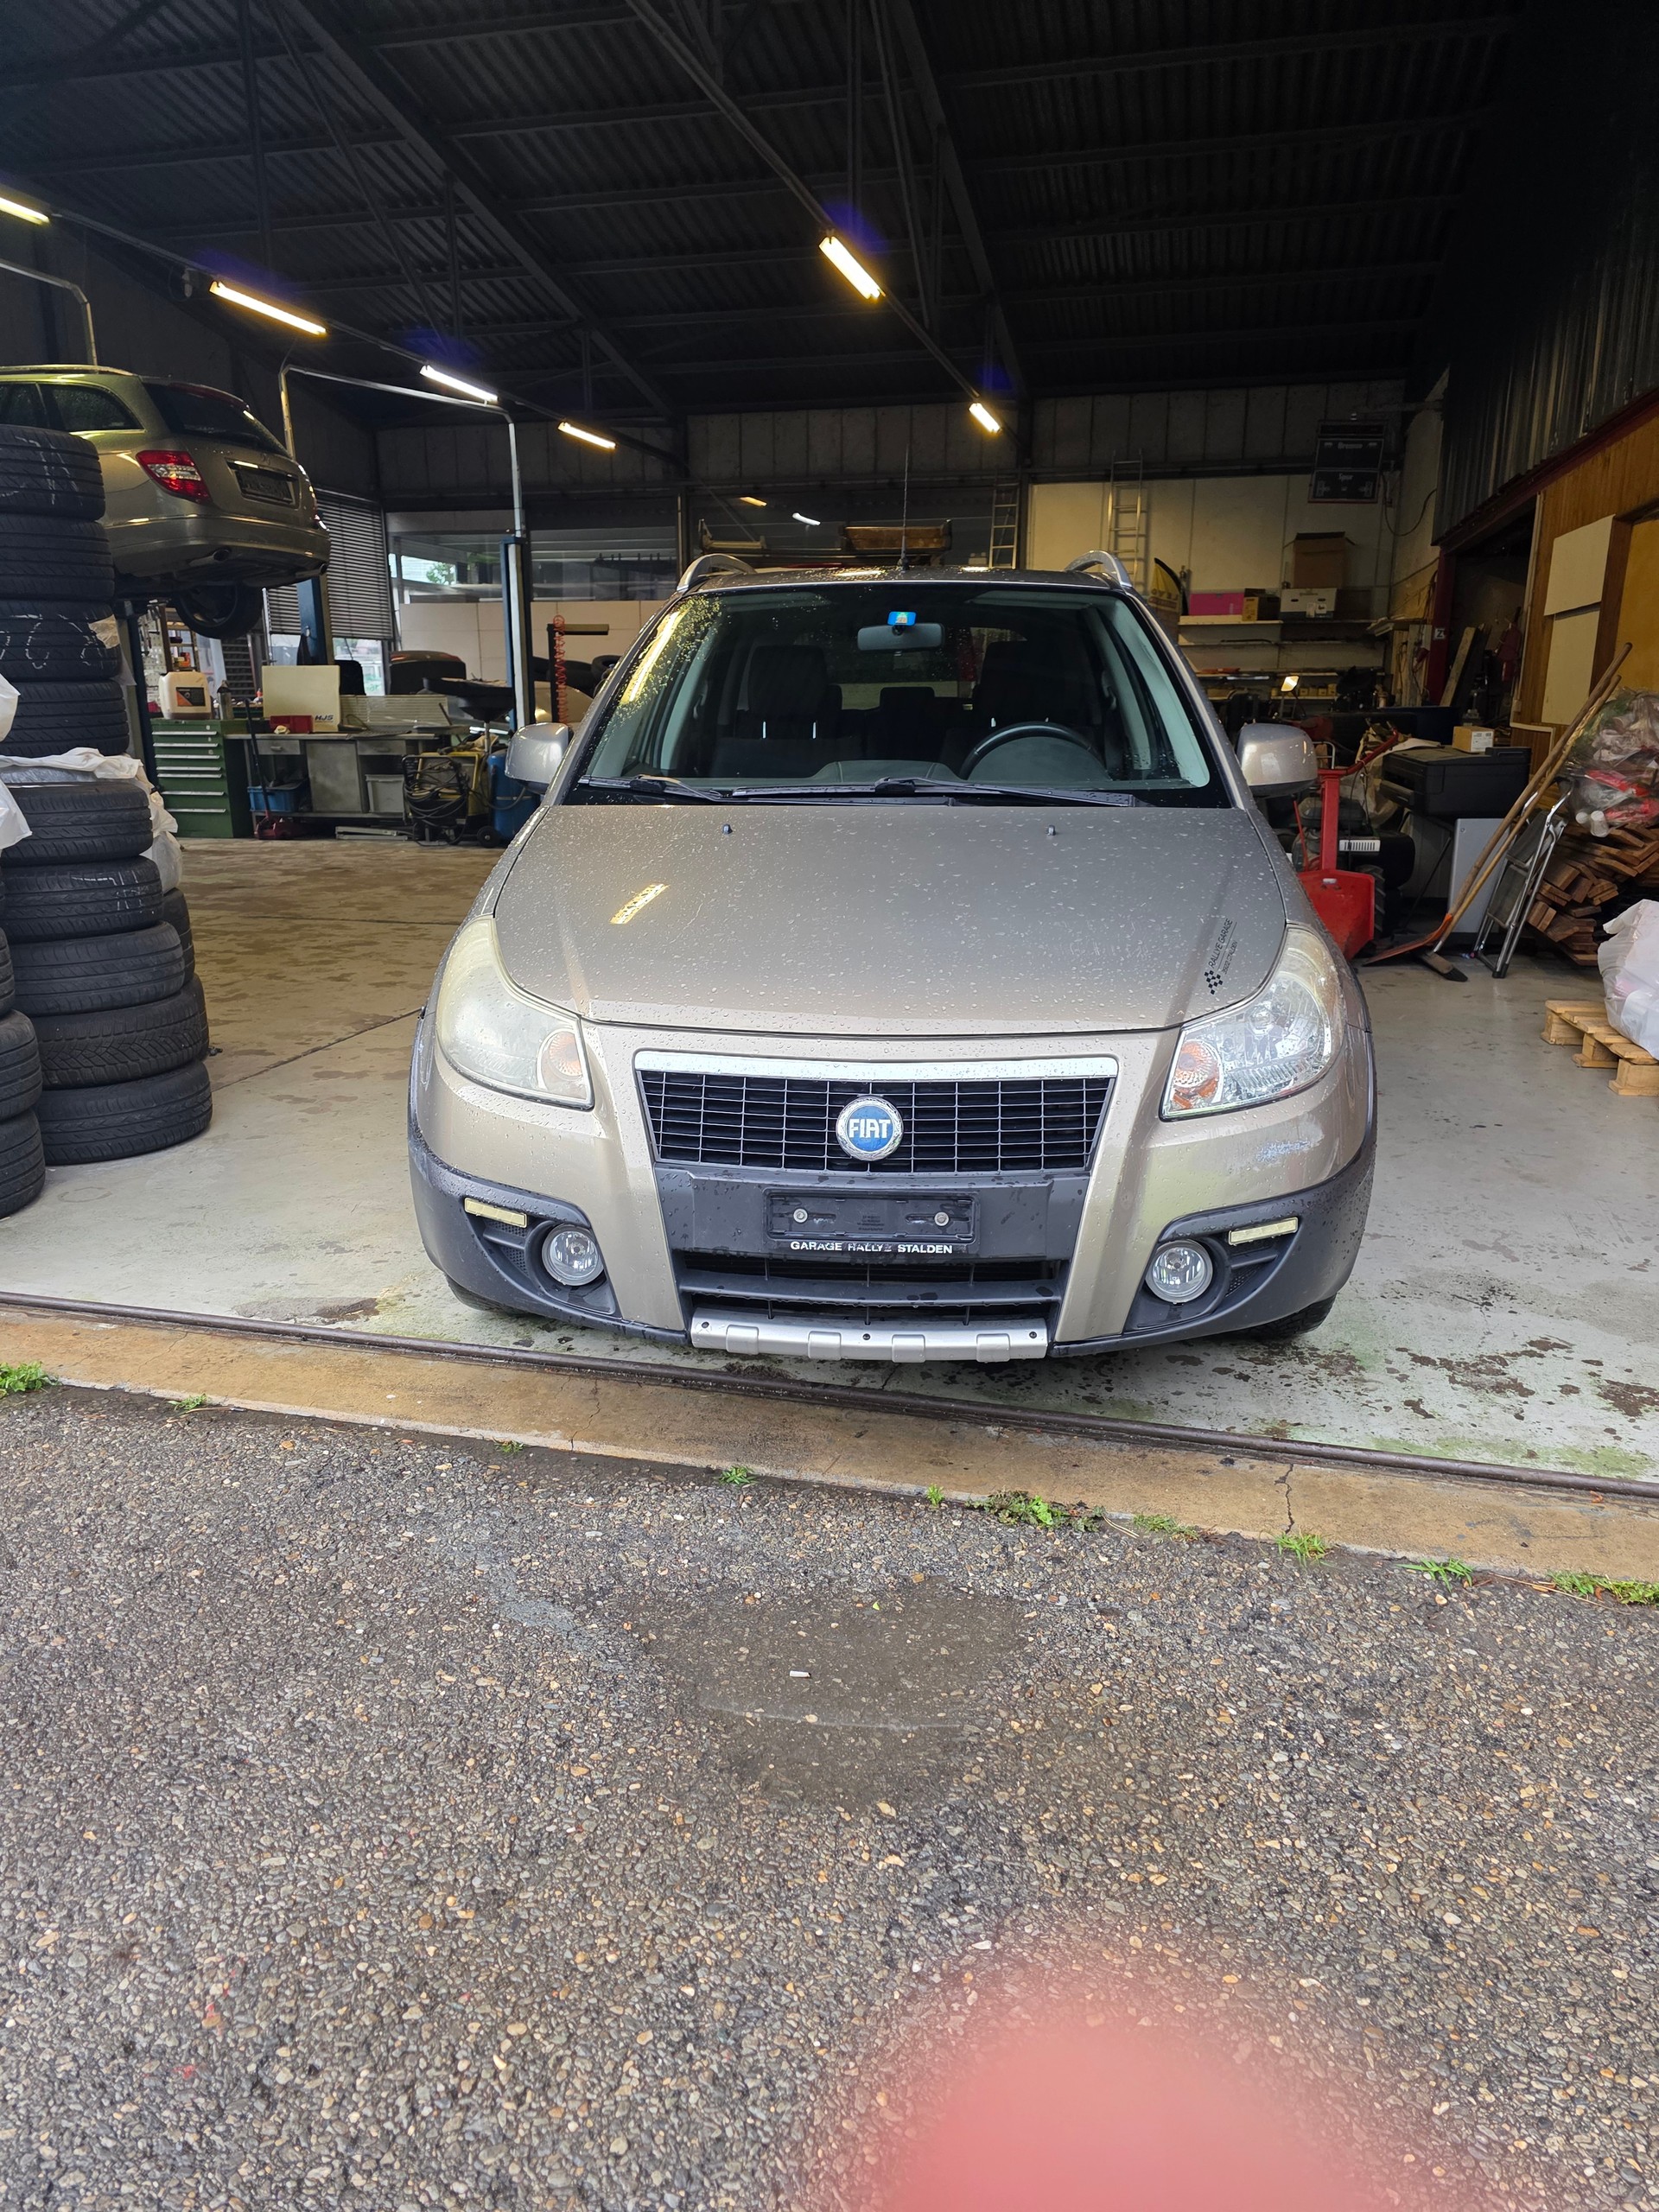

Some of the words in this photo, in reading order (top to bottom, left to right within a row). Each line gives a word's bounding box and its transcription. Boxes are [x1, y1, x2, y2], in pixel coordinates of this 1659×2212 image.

[1208, 943, 1223, 969] RALLYE
[1217, 918, 1233, 944] GARAGE
[849, 1118, 891, 1139] FIAT
[790, 1241, 843, 1251] GARAGE
[897, 1244, 953, 1254] STALDEN
